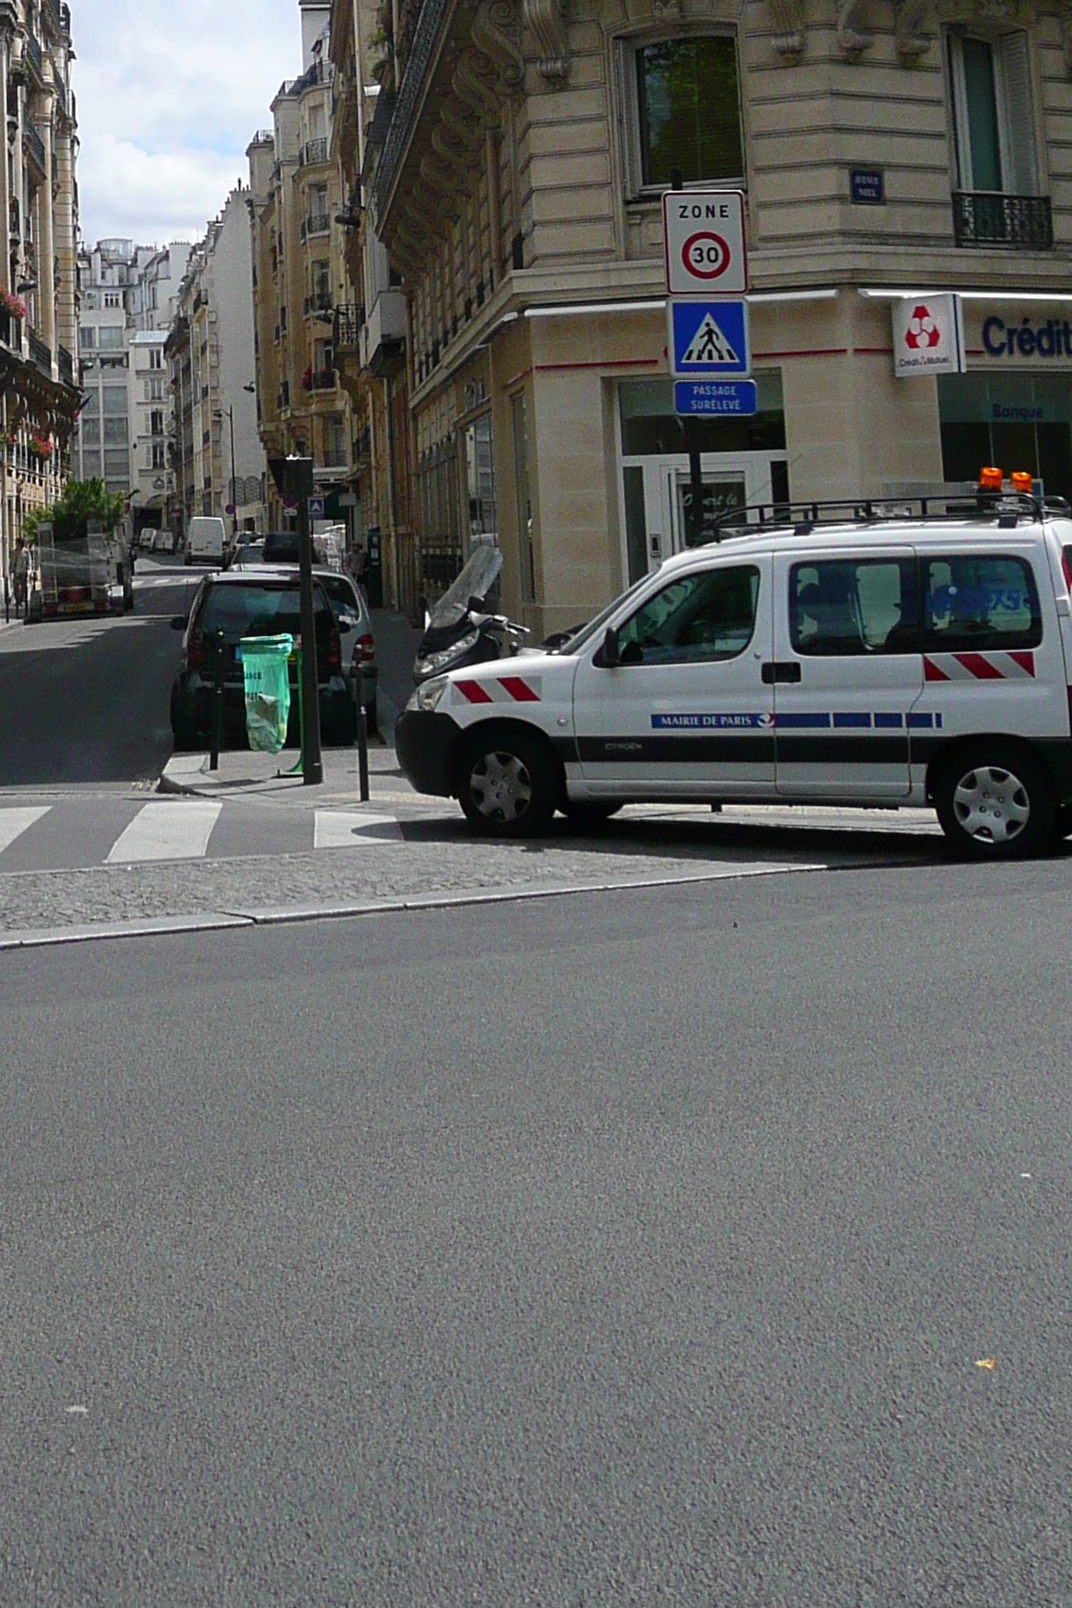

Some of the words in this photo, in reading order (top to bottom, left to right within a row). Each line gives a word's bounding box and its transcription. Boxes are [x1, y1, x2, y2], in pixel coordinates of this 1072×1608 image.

[678, 204, 730, 219] ZONE
[693, 247, 719, 264] 30
[693, 385, 737, 395] PASSAGE
[993, 403, 1044, 421] Banque
[661, 716, 699, 726] MAIRIE
[702, 716, 718, 726] DE
[721, 716, 752, 726] PARIS
